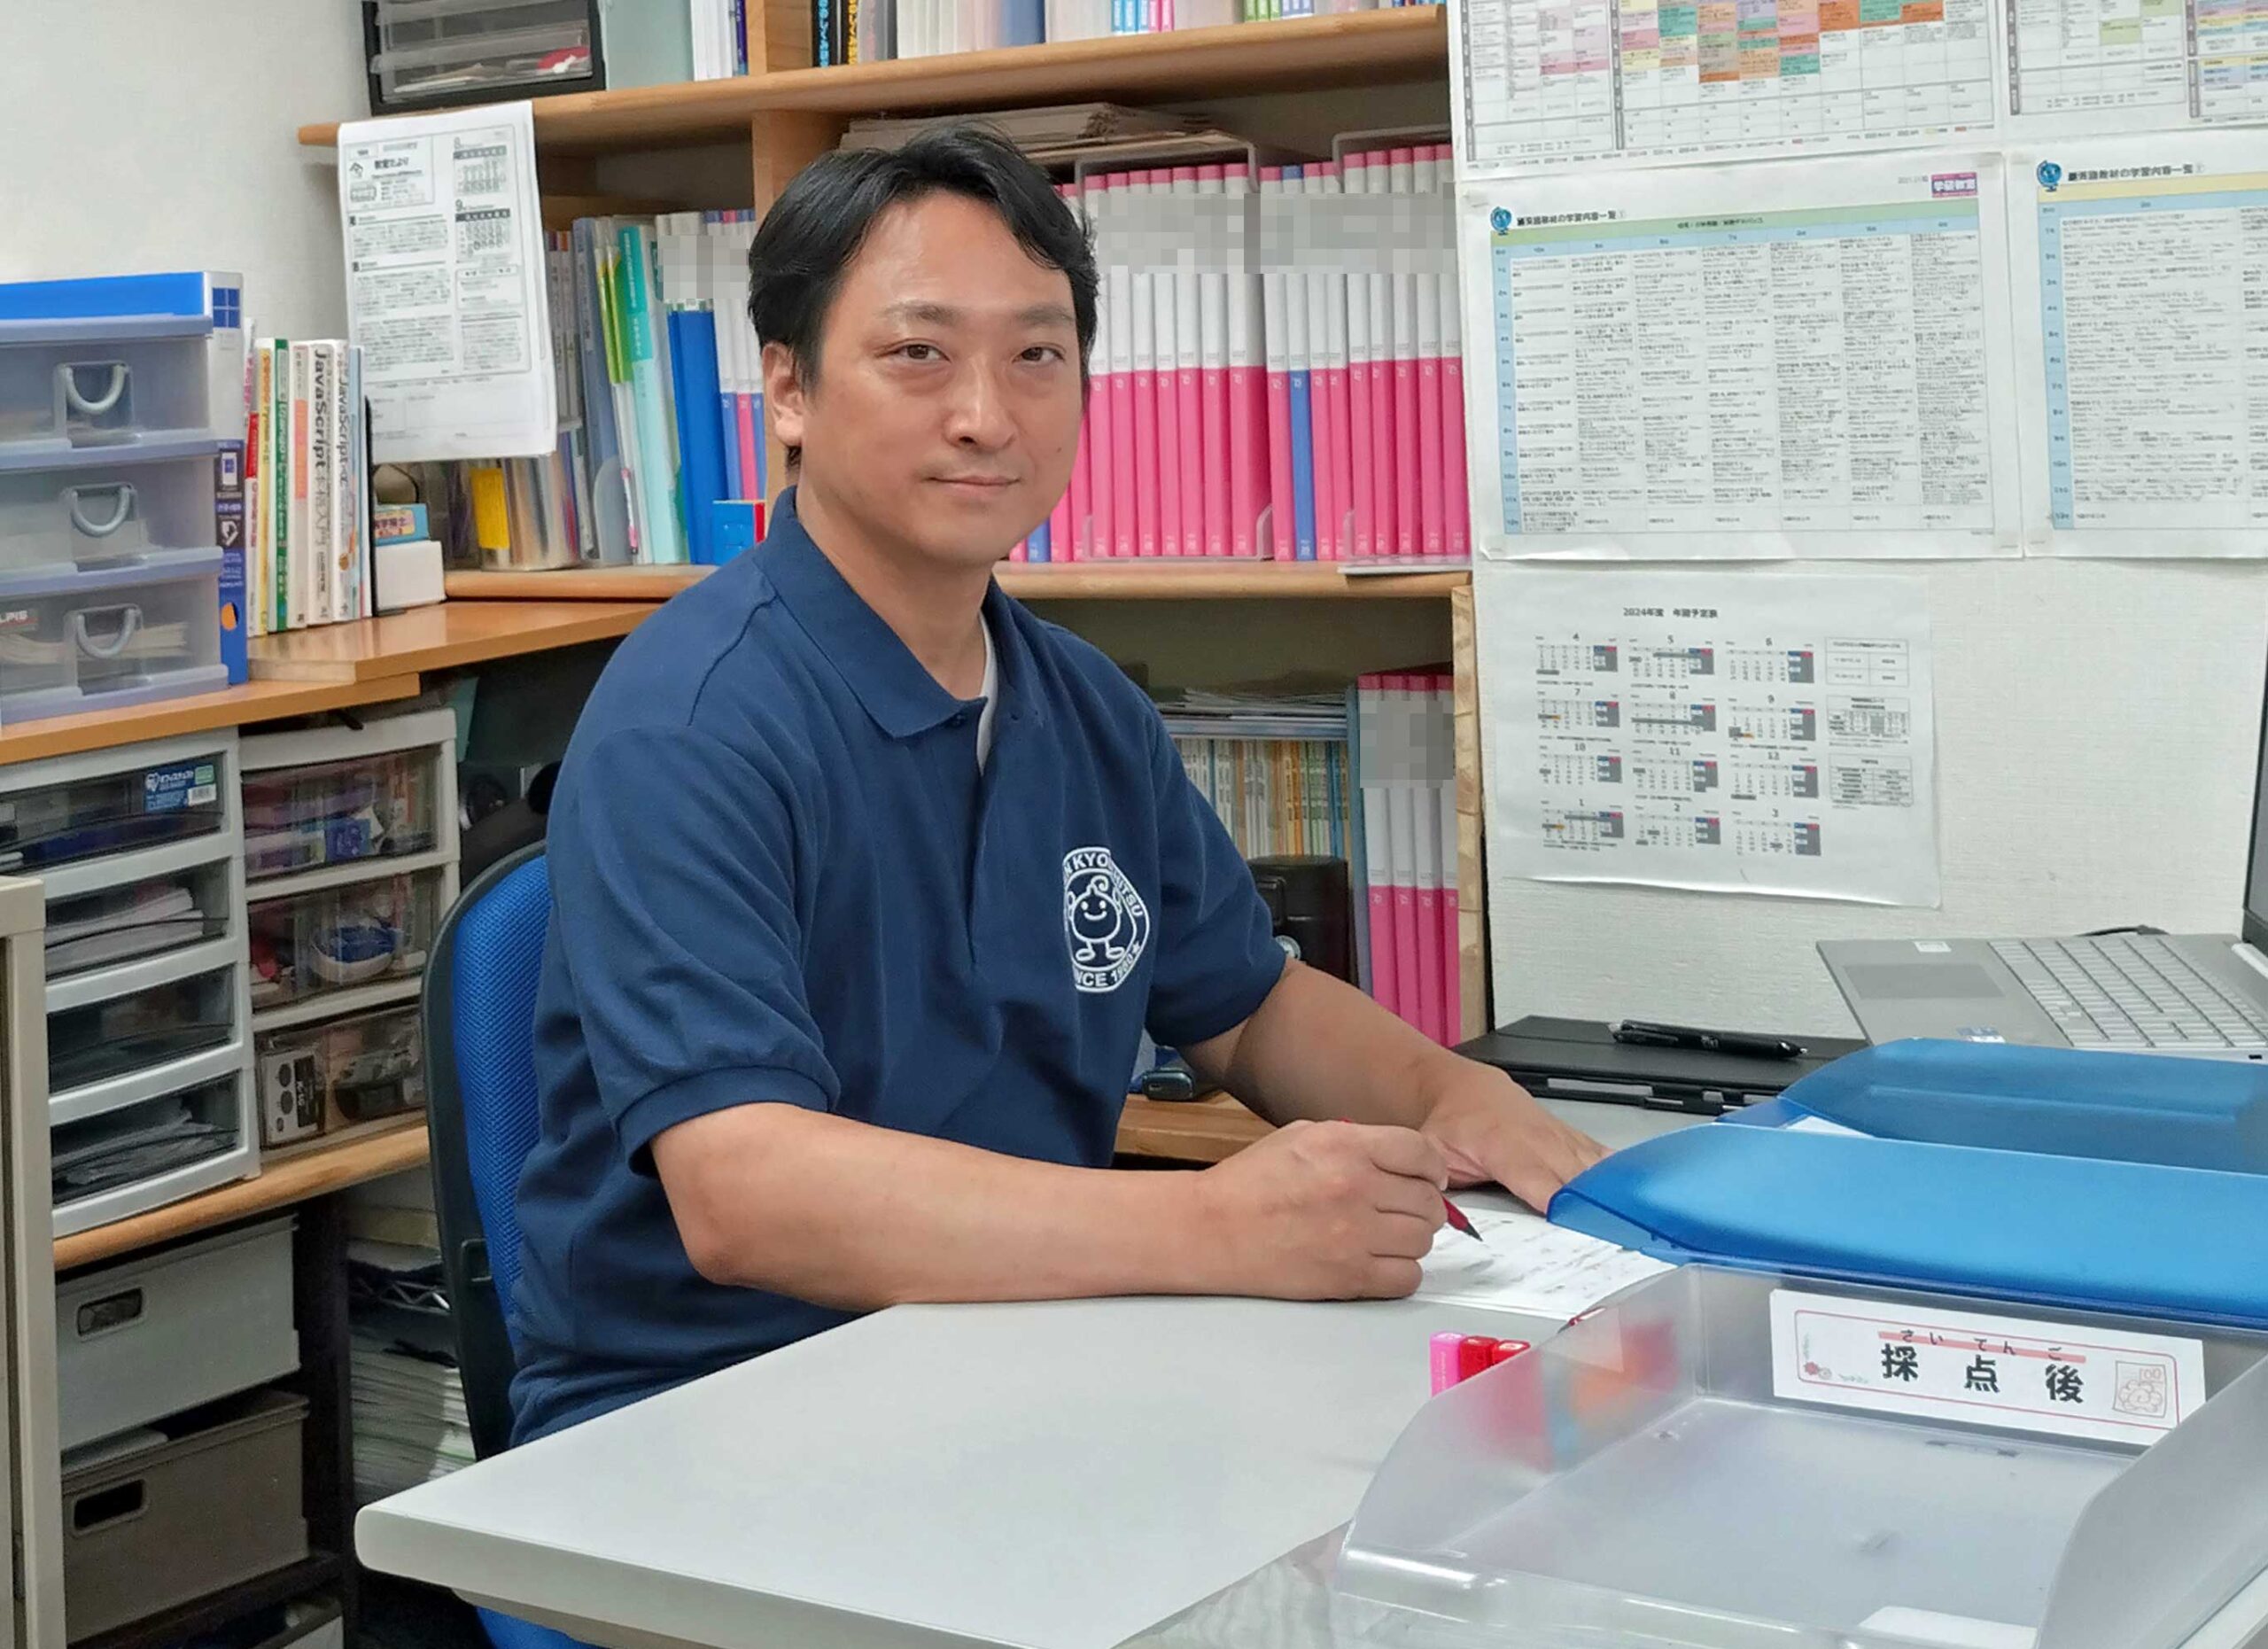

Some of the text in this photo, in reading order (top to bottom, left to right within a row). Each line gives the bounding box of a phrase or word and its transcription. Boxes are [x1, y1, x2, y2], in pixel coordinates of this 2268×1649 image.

[313, 348, 327, 468] JavaScript
[1880, 1342, 2085, 1404] 採点後
